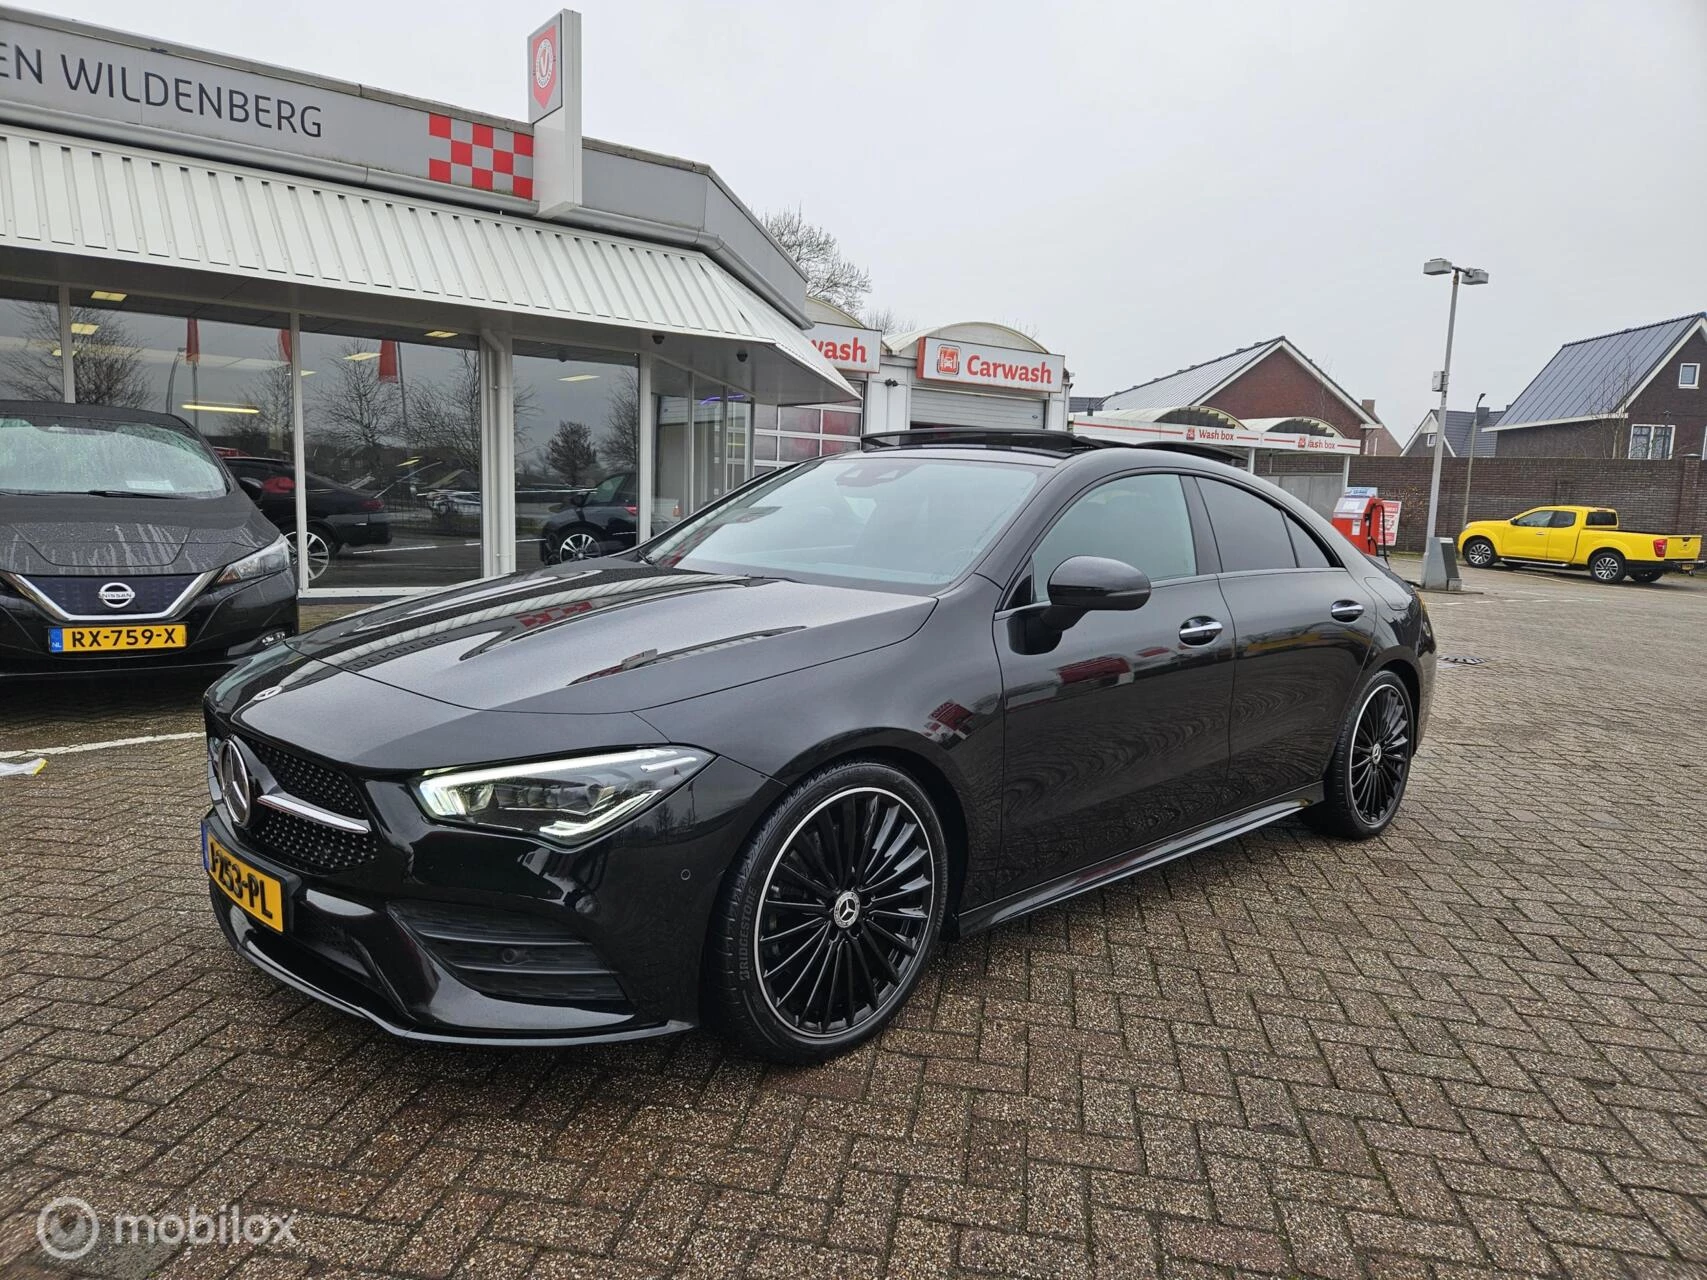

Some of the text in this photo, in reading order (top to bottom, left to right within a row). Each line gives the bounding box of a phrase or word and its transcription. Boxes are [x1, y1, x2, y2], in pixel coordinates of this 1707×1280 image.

[60, 53, 322, 138] WILDENBERG
[967, 354, 1052, 384] Carwash
[1199, 429, 1234, 441] Wash box
[1307, 439, 1336, 449] ash box
[72, 628, 176, 648] RX-759-X
